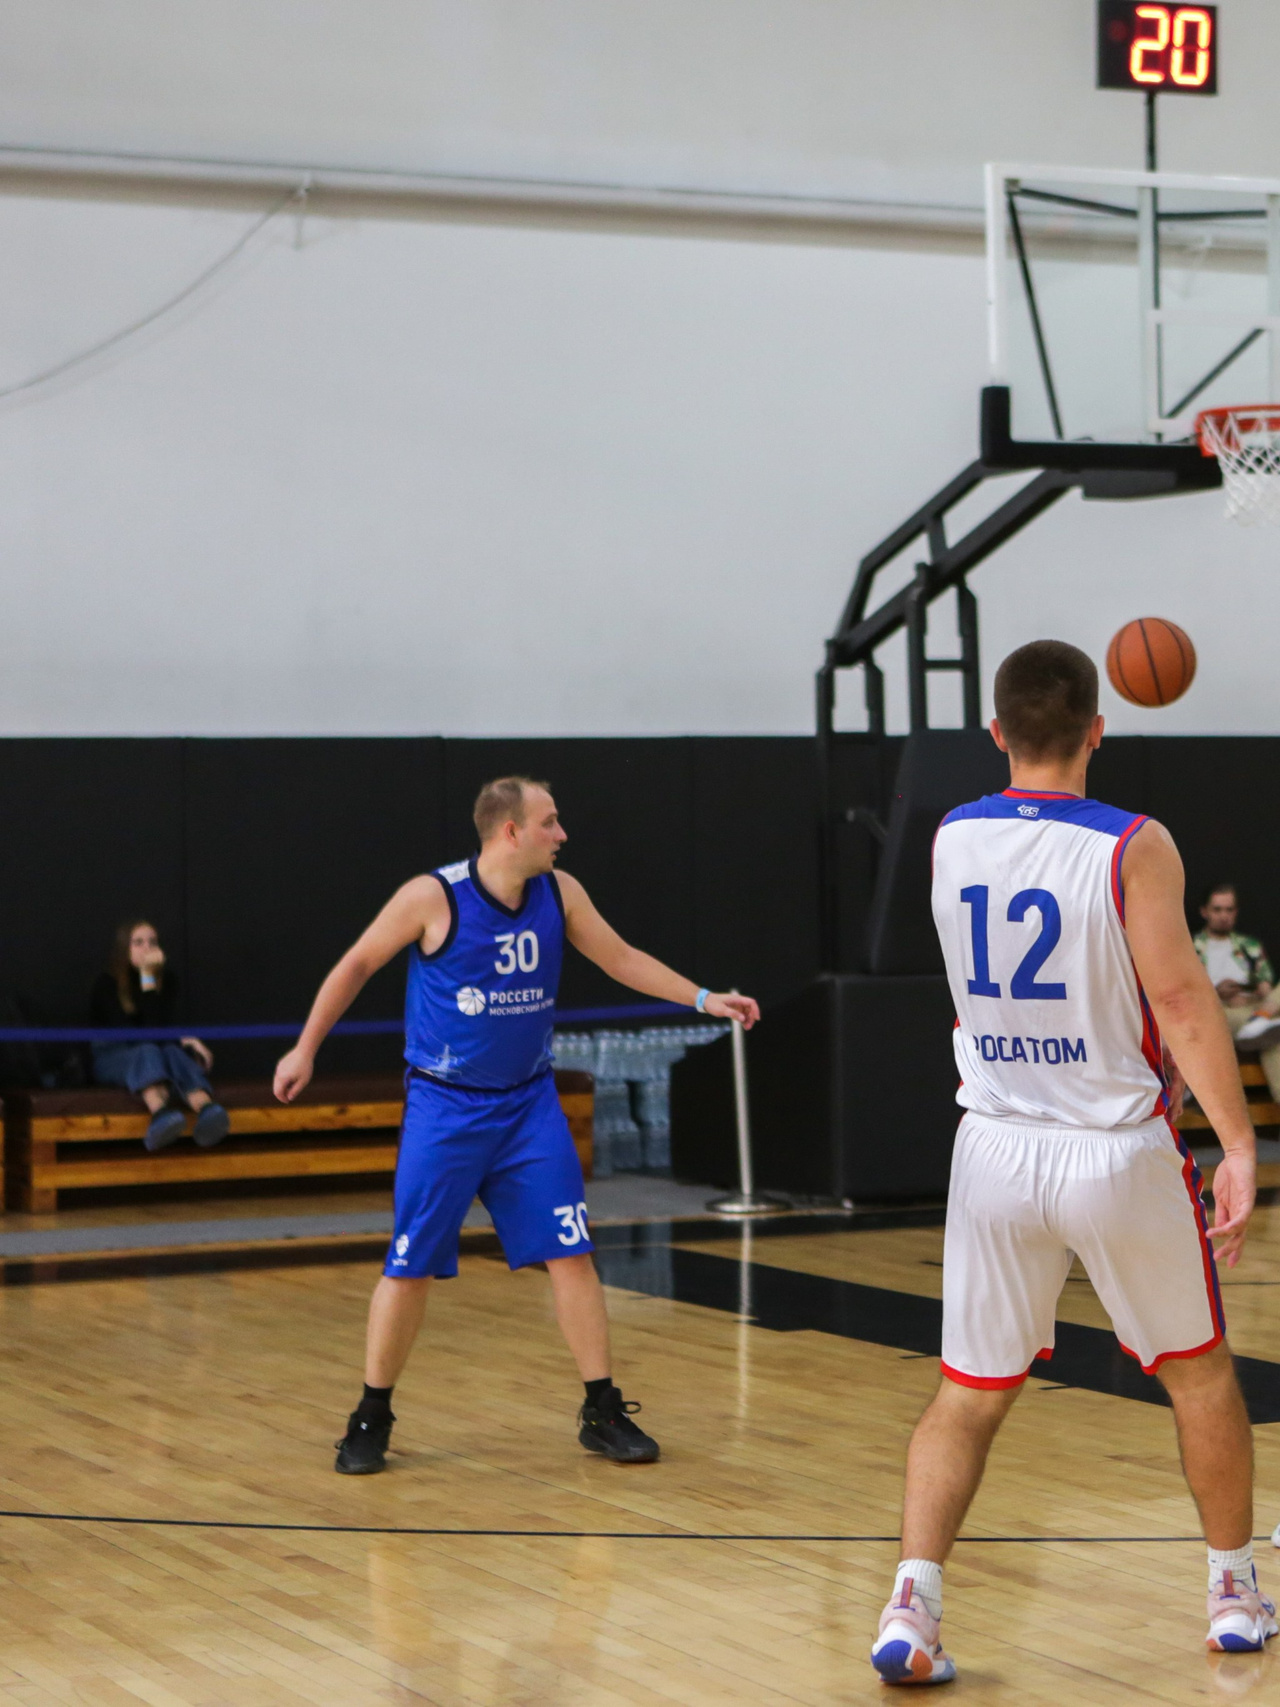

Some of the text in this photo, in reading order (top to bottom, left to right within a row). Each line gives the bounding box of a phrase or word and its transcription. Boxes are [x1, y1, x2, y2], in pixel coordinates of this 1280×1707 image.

[1130, 4, 1211, 87] 20
[494, 930, 539, 975] 30
[960, 884, 1067, 1000] 12
[489, 988, 543, 1005] РОССЕТИ
